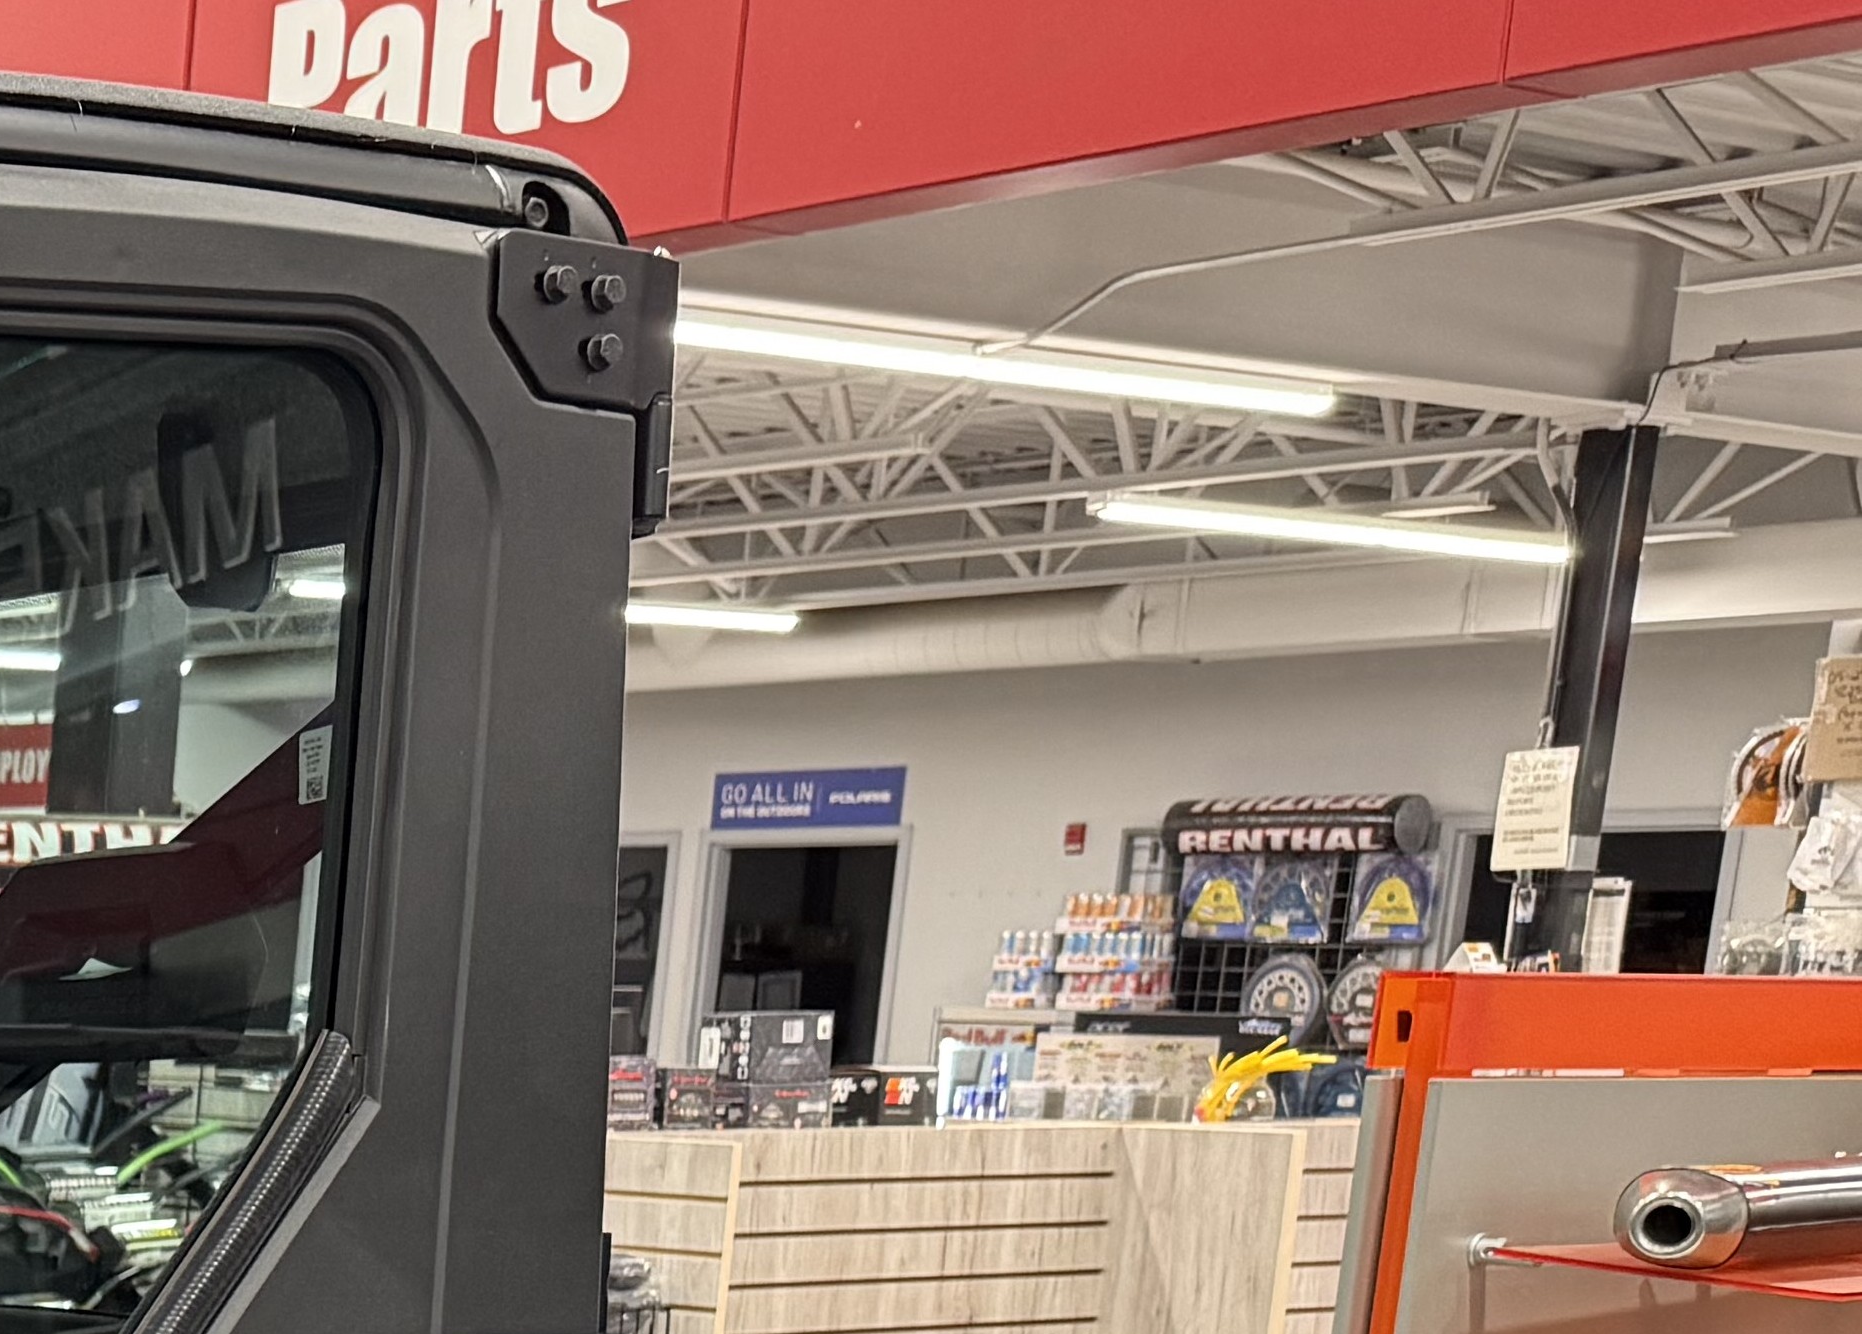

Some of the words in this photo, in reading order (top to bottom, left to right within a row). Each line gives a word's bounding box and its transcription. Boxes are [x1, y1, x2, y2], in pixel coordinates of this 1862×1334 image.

[268, 0, 630, 135] Parts
[721, 783, 747, 805] GO
[751, 780, 787, 804] ALL
[792, 780, 815, 802] IN
[1177, 825, 1385, 854] RENTHAL
